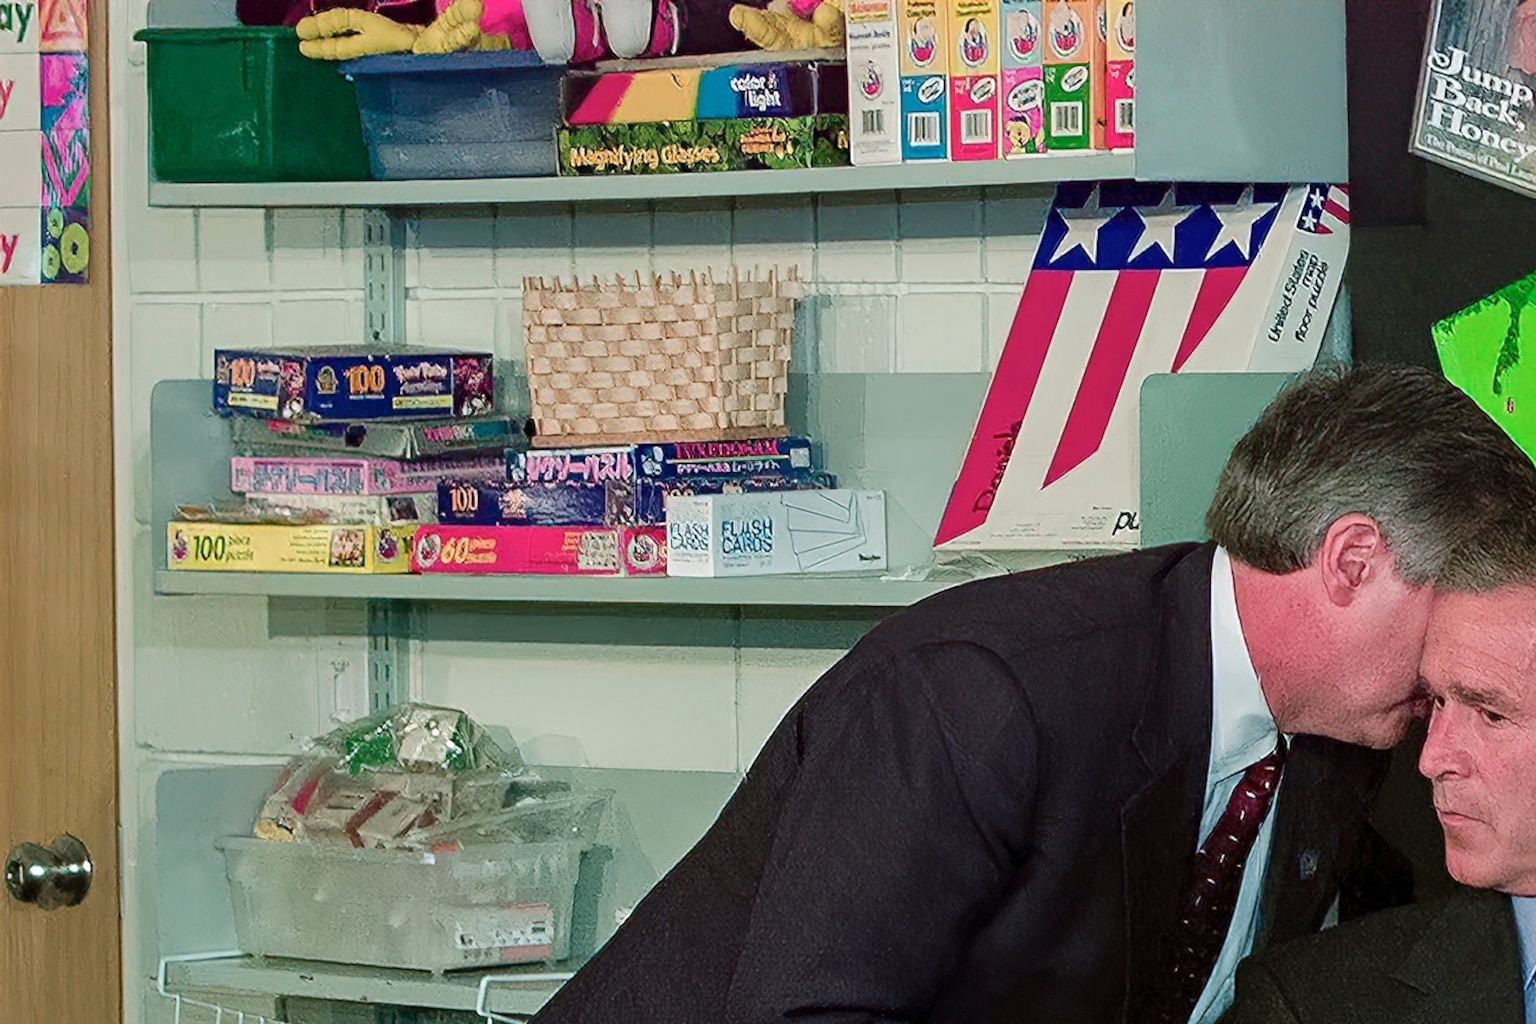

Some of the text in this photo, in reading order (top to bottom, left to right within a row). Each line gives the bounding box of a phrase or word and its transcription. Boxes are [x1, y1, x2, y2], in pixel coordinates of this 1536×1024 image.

[1427, 46, 1535, 111] Jump
[1431, 74, 1526, 132] Back,
[569, 144, 721, 171] Magnifying Glasses
[1301, 254, 1319, 288] map
[1268, 249, 1309, 343] United States
[450, 486, 478, 512] 100
[722, 518, 773, 537] FLASH
[193, 535, 226, 561] 100
[441, 535, 468, 564] 60
[722, 537, 773, 553] CARDS
